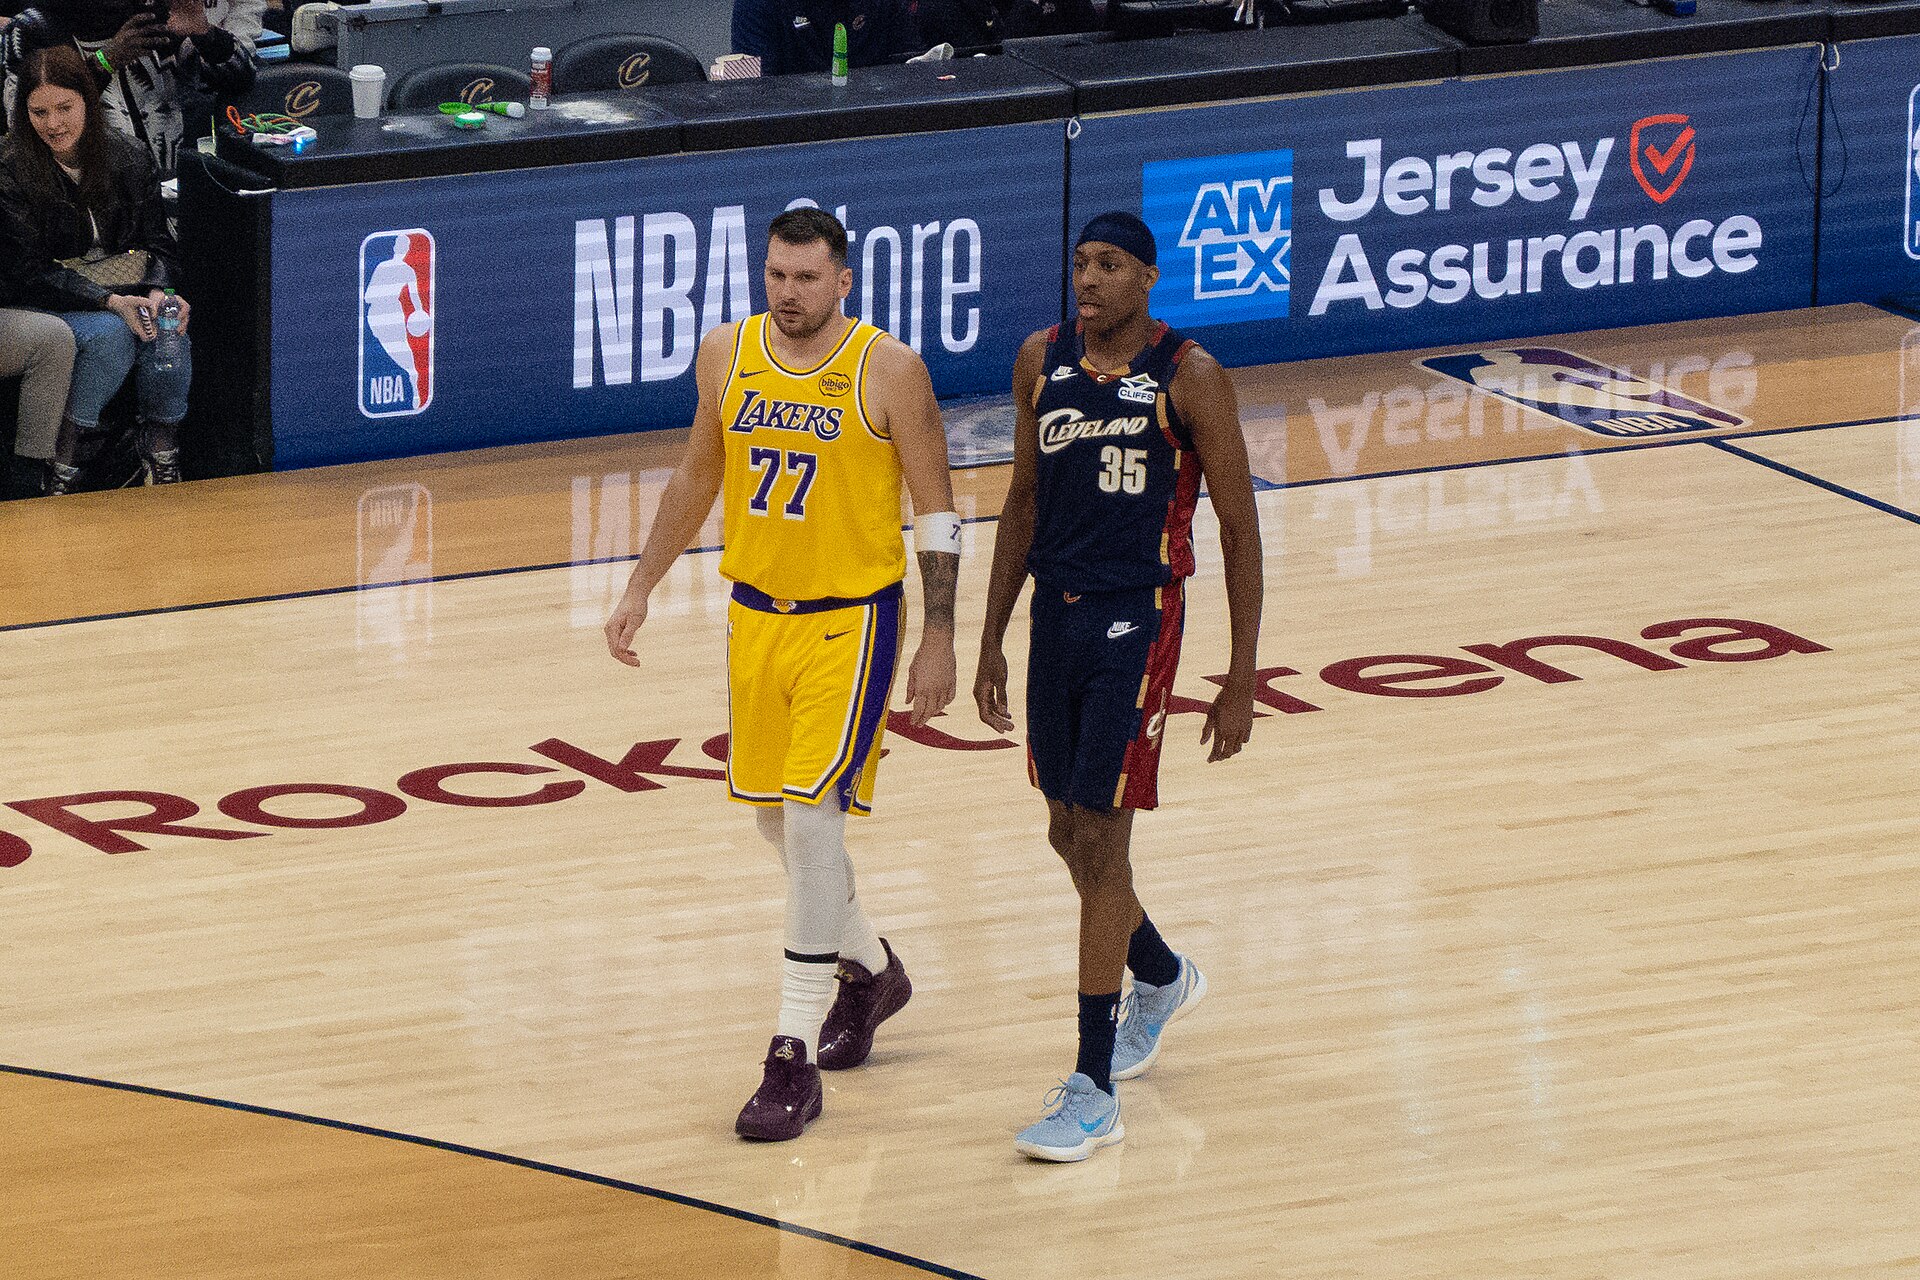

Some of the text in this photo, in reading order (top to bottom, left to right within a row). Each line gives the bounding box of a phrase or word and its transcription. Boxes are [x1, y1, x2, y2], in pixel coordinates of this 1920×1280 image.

[1318, 137, 1615, 221] Jersey
[1178, 176, 1293, 247] AM
[1194, 234, 1292, 300] EX
[1308, 215, 1763, 316] Assurance
[573, 197, 981, 389] NBA ore
[370, 374, 404, 404] NBA
[822, 378, 850, 390] bibigo
[1119, 388, 1154, 402] CLIFFS
[728, 388, 845, 442] LAKERS
[1038, 408, 1149, 454] CLEVELAND
[1590, 414, 1692, 434] NBA
[748, 445, 818, 522] 77
[1098, 445, 1148, 495] 35
[950, 523, 961, 542] 7
[1112, 621, 1132, 632] NIKE
[8, 706, 1021, 855] Rockt
